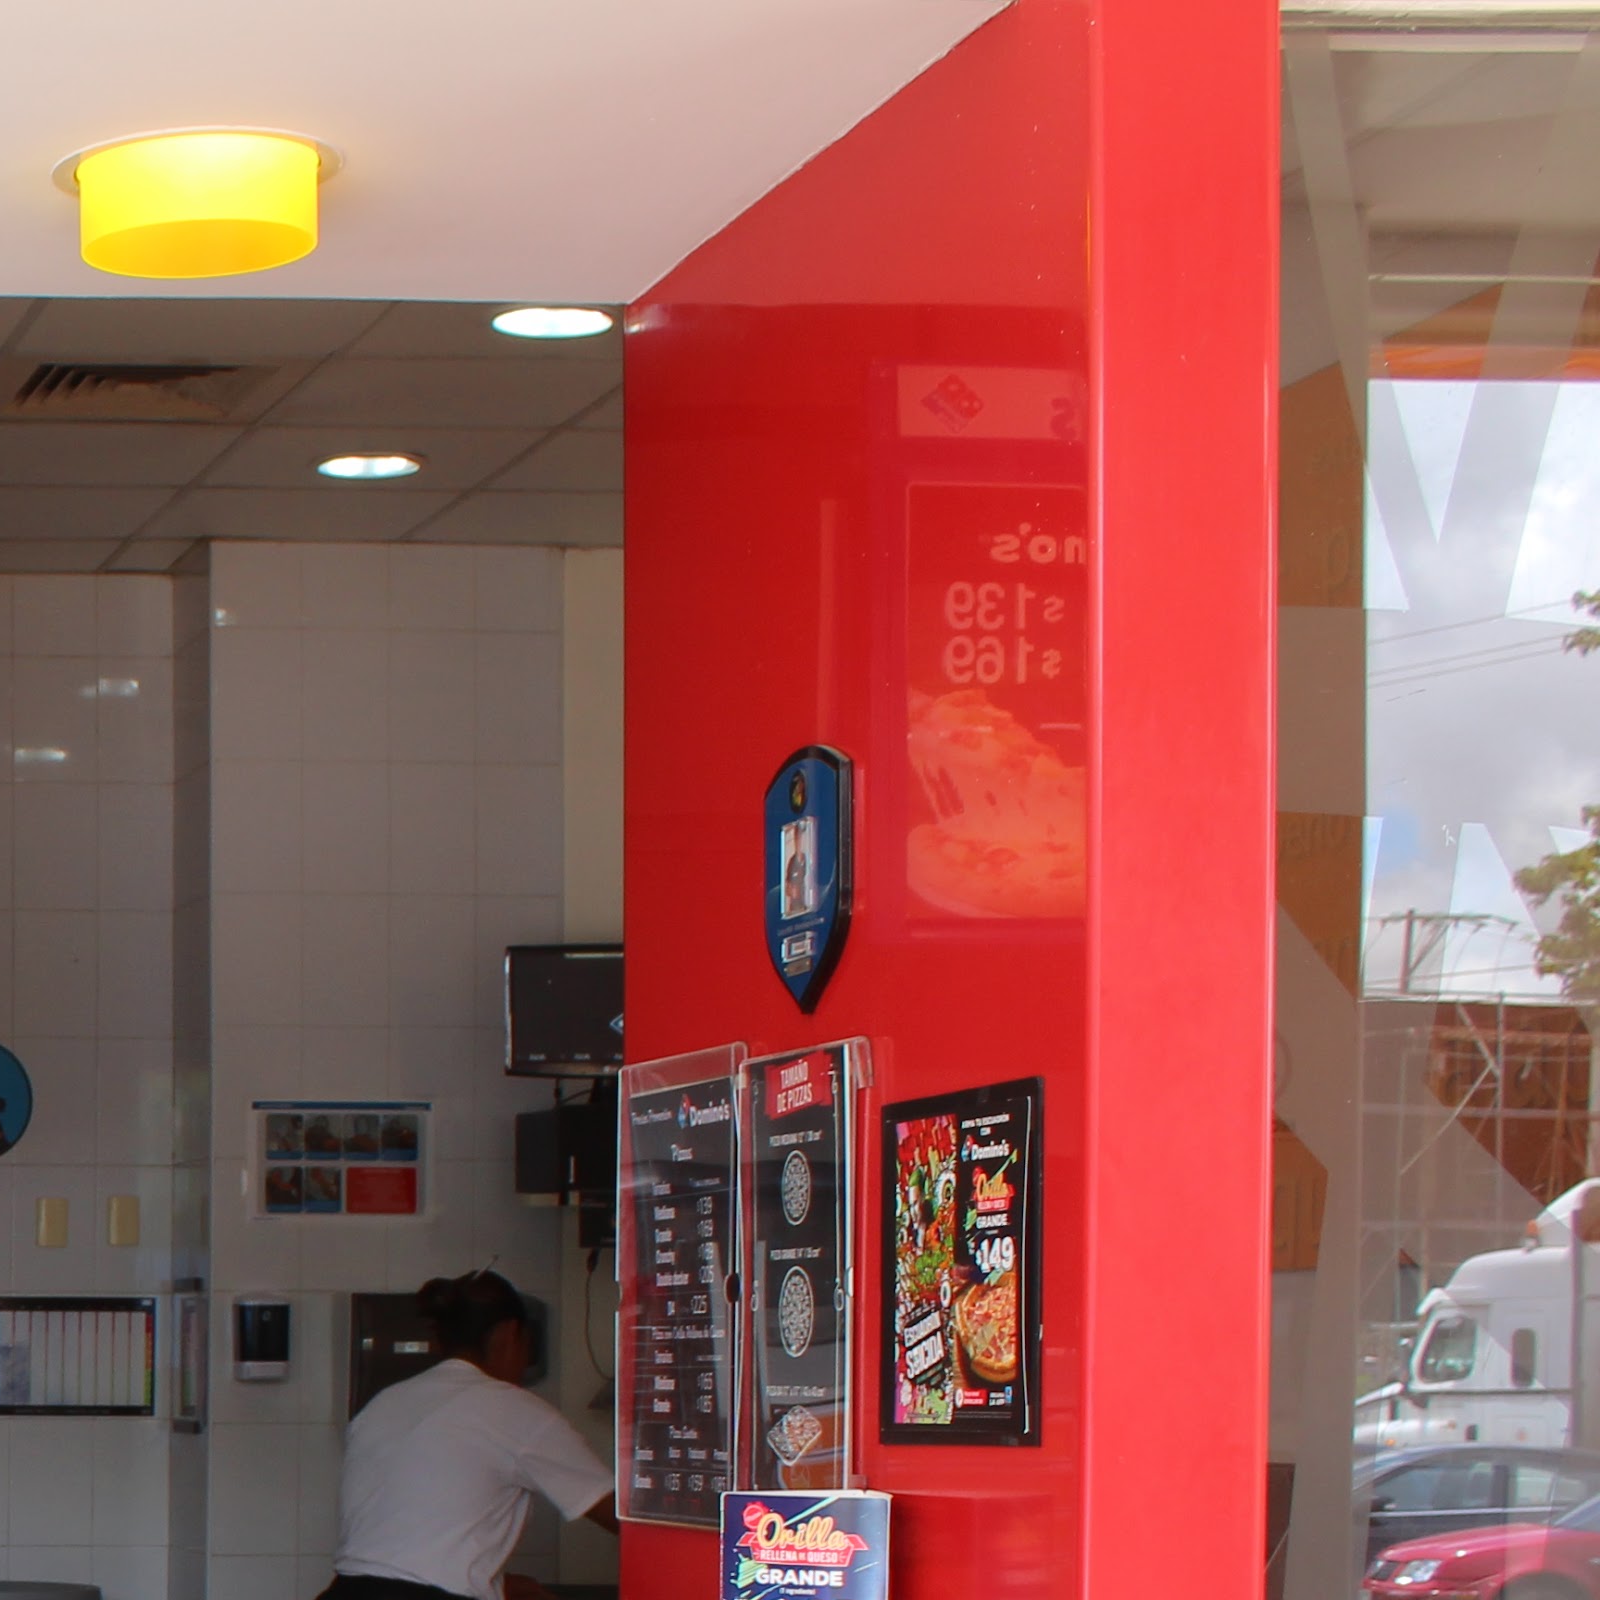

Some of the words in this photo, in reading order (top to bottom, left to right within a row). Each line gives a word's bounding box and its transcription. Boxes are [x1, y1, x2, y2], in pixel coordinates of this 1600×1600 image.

[975, 1213, 1009, 1229] GRANDE
[756, 1512, 850, 1551] Orilla
[760, 1549, 798, 1561] RELLENA
[807, 1551, 838, 1564] QUESO
[755, 1568, 843, 1587] GRANDE
